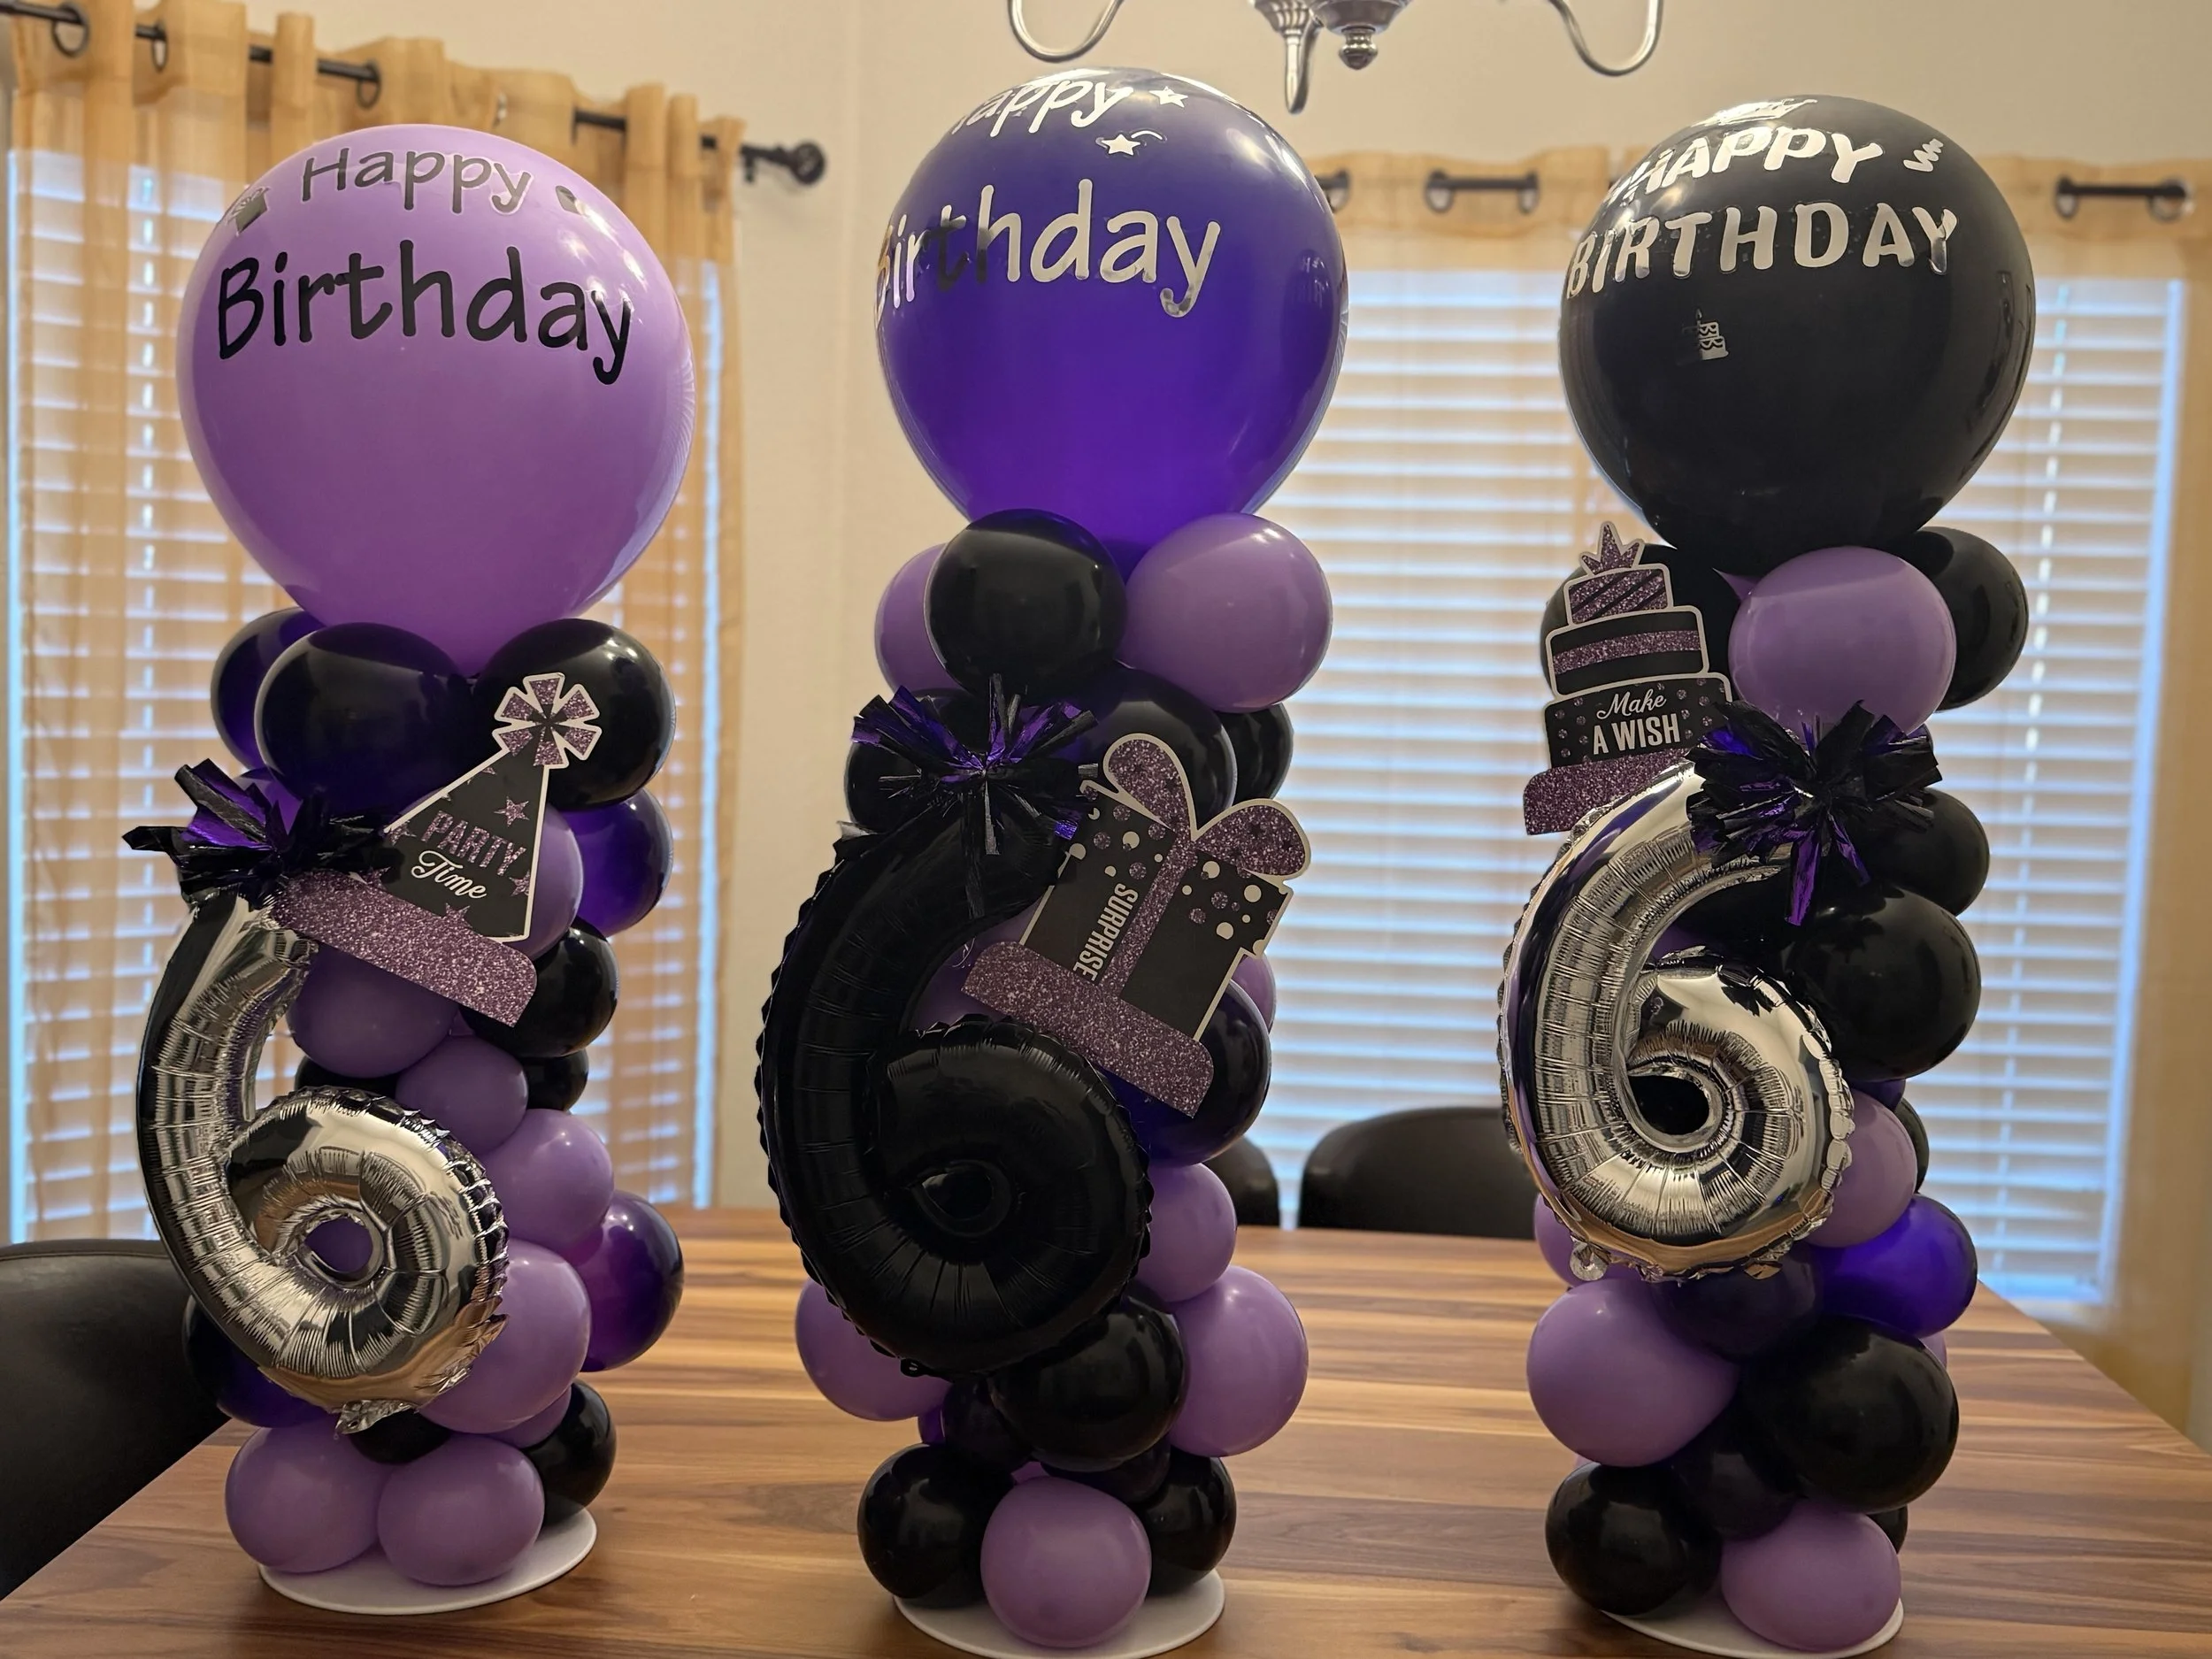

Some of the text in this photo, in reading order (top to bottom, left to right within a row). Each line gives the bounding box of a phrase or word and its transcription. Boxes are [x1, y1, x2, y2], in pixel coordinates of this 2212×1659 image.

[951, 80, 1134, 138] appy
[301, 147, 533, 214] Happy
[1622, 125, 1885, 198] HAPPY
[1566, 202, 1959, 299] BIRTHDAY
[219, 239, 633, 385] Birthday
[1594, 712, 1681, 755] A WISH
[1596, 688, 1667, 720] Make
[411, 849, 488, 899] Time
[420, 810, 527, 876] PARTY
[1072, 883, 1139, 981] SURPRISE
[1497, 759, 1855, 1283] 6
